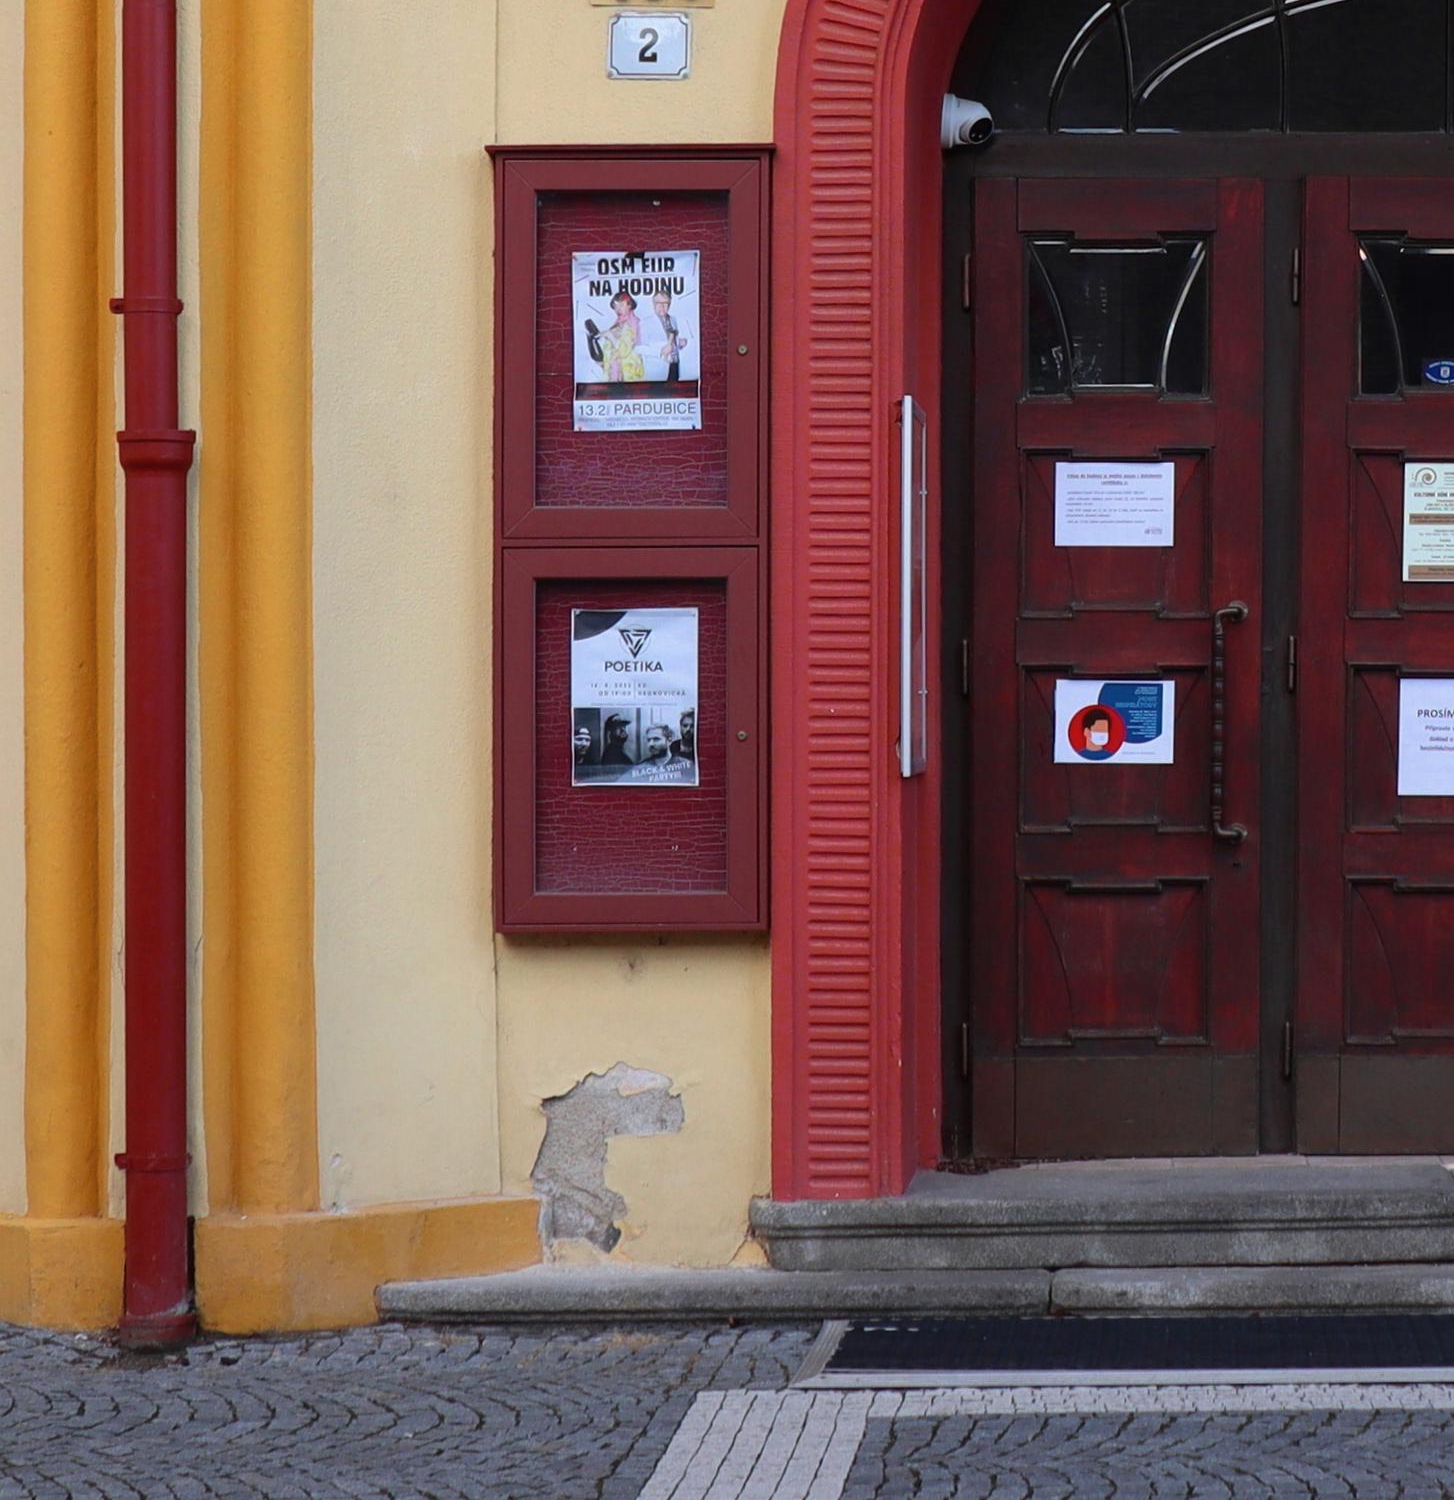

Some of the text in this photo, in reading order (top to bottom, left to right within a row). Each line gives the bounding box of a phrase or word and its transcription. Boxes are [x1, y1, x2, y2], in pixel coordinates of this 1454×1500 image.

[638, 27, 659, 63] 2
[597, 258, 635, 275] OSM
[589, 276, 685, 298] NA HODINU
[614, 402, 697, 416] PARDUBICE
[604, 660, 664, 673] POETIKA
